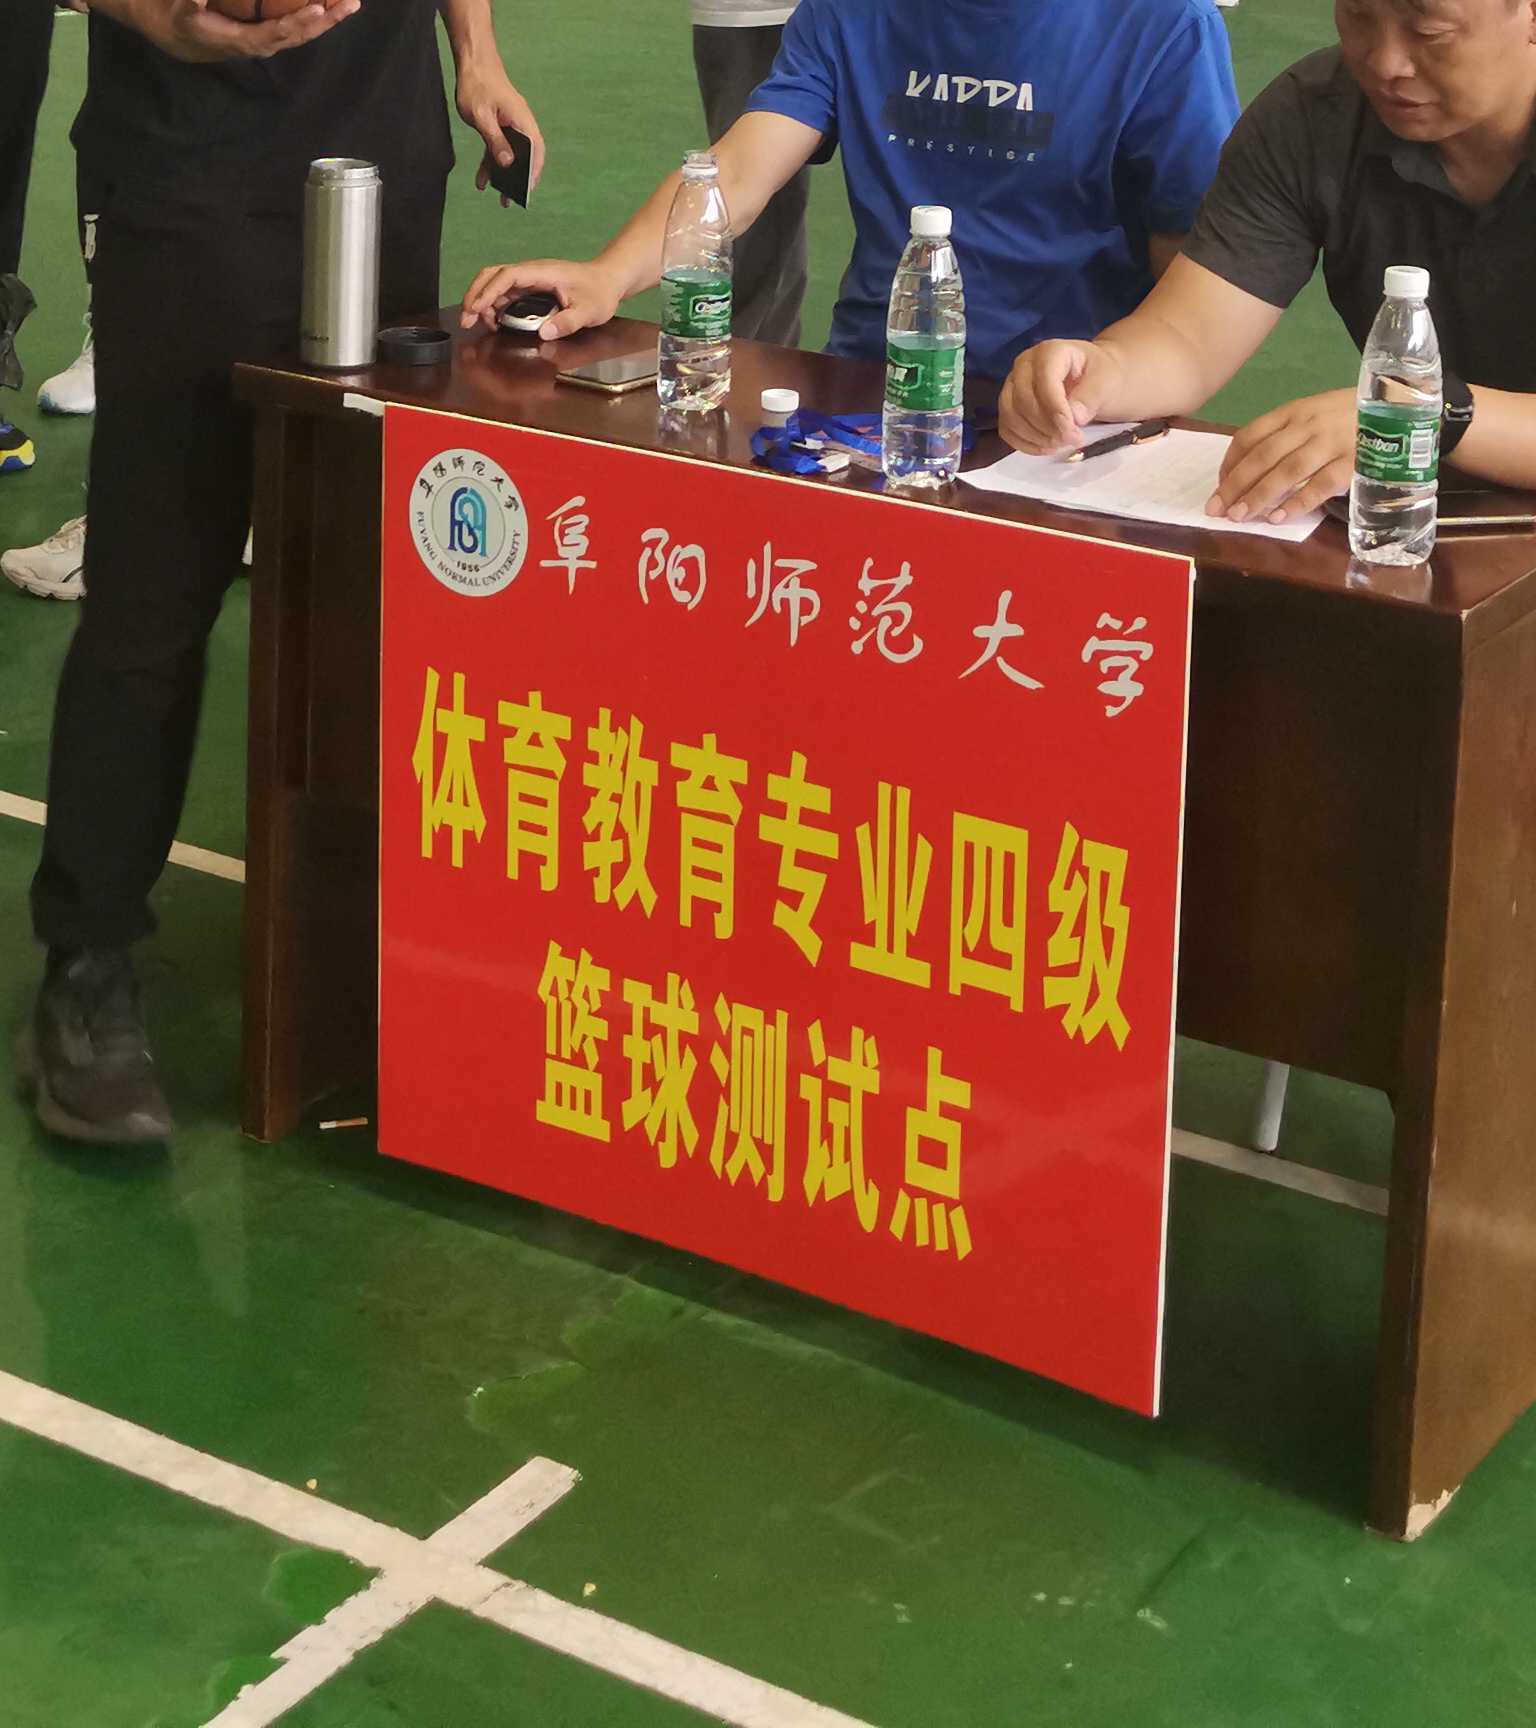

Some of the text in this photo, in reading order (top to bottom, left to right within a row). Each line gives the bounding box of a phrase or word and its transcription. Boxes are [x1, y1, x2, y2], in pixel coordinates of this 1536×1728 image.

[538, 494, 1155, 719] 阜阳师范大学
[411, 665, 1132, 1052] 体育教育专业四级
[535, 939, 973, 1261] 篮球测试点
